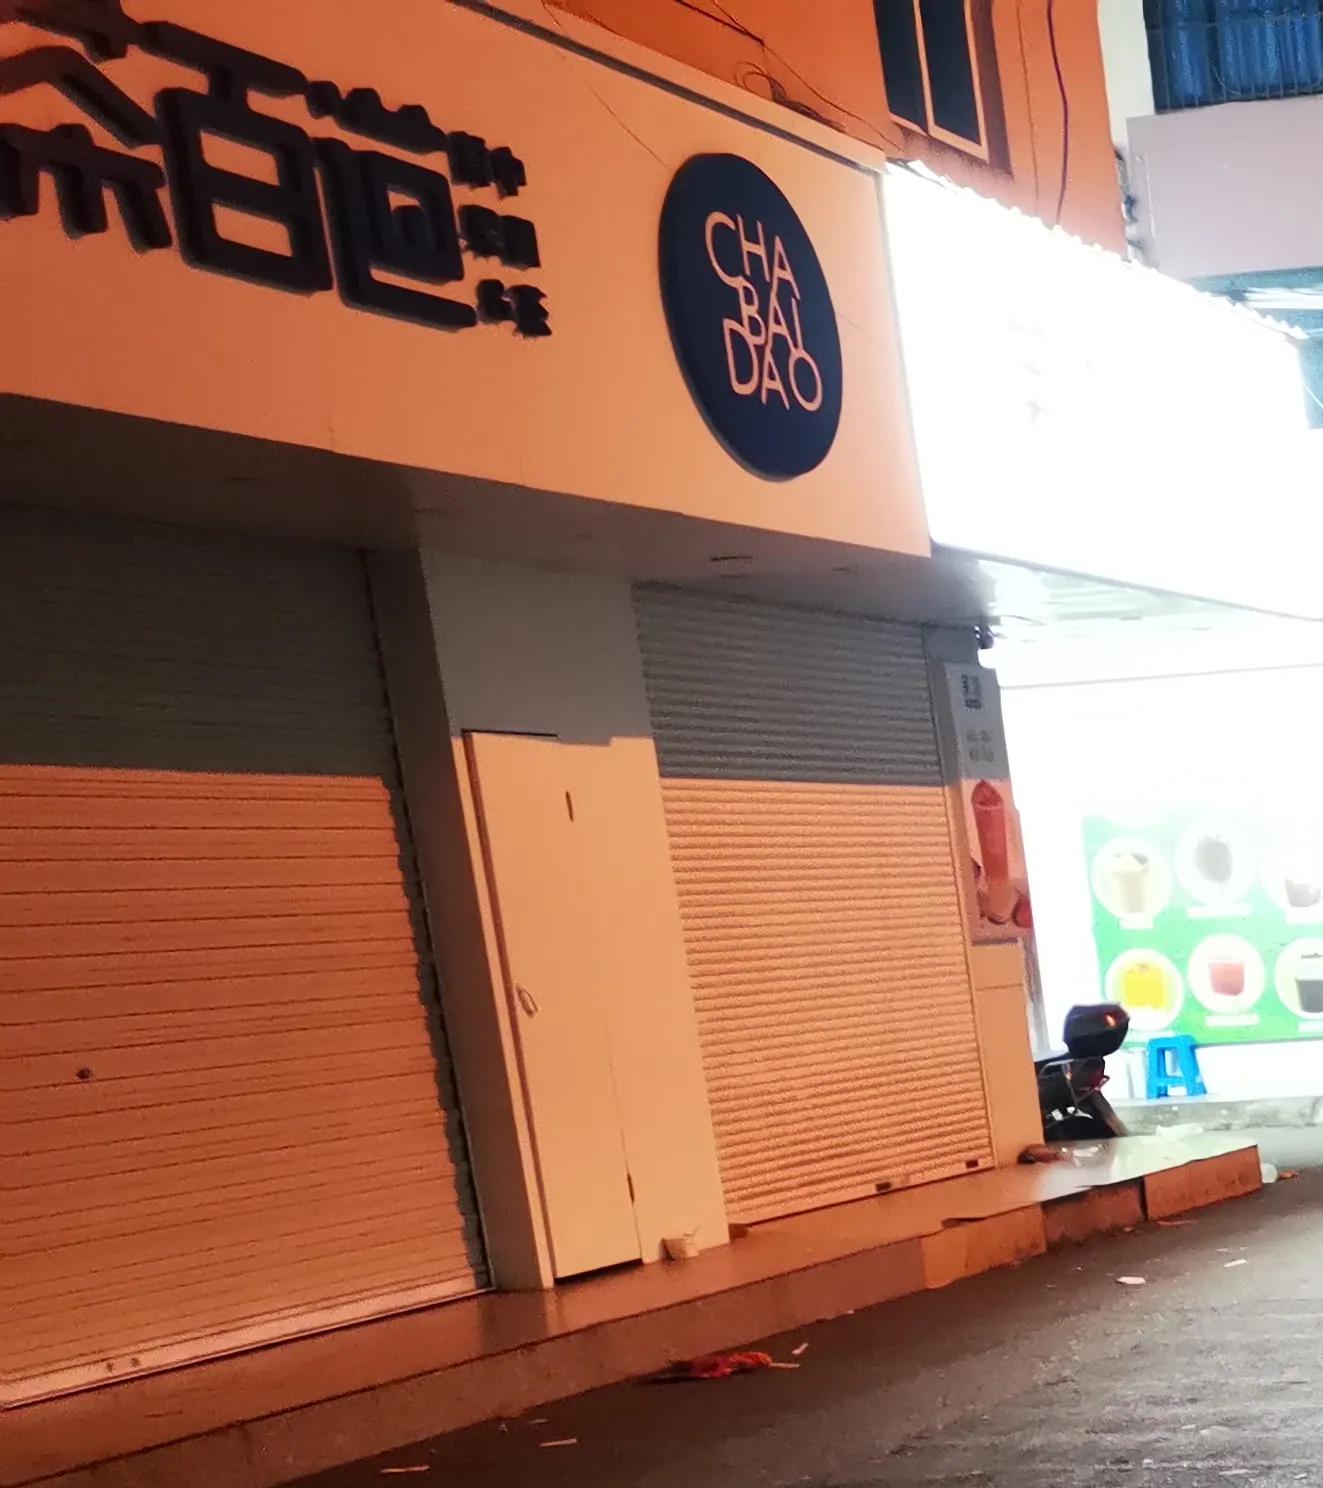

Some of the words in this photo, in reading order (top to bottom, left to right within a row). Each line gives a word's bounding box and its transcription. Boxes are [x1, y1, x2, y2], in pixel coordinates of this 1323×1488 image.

[0, 0, 478, 330] 茶百道
[705, 211, 800, 299] CHA
[738, 276, 804, 352] BAI
[722, 318, 823, 411] DAO
